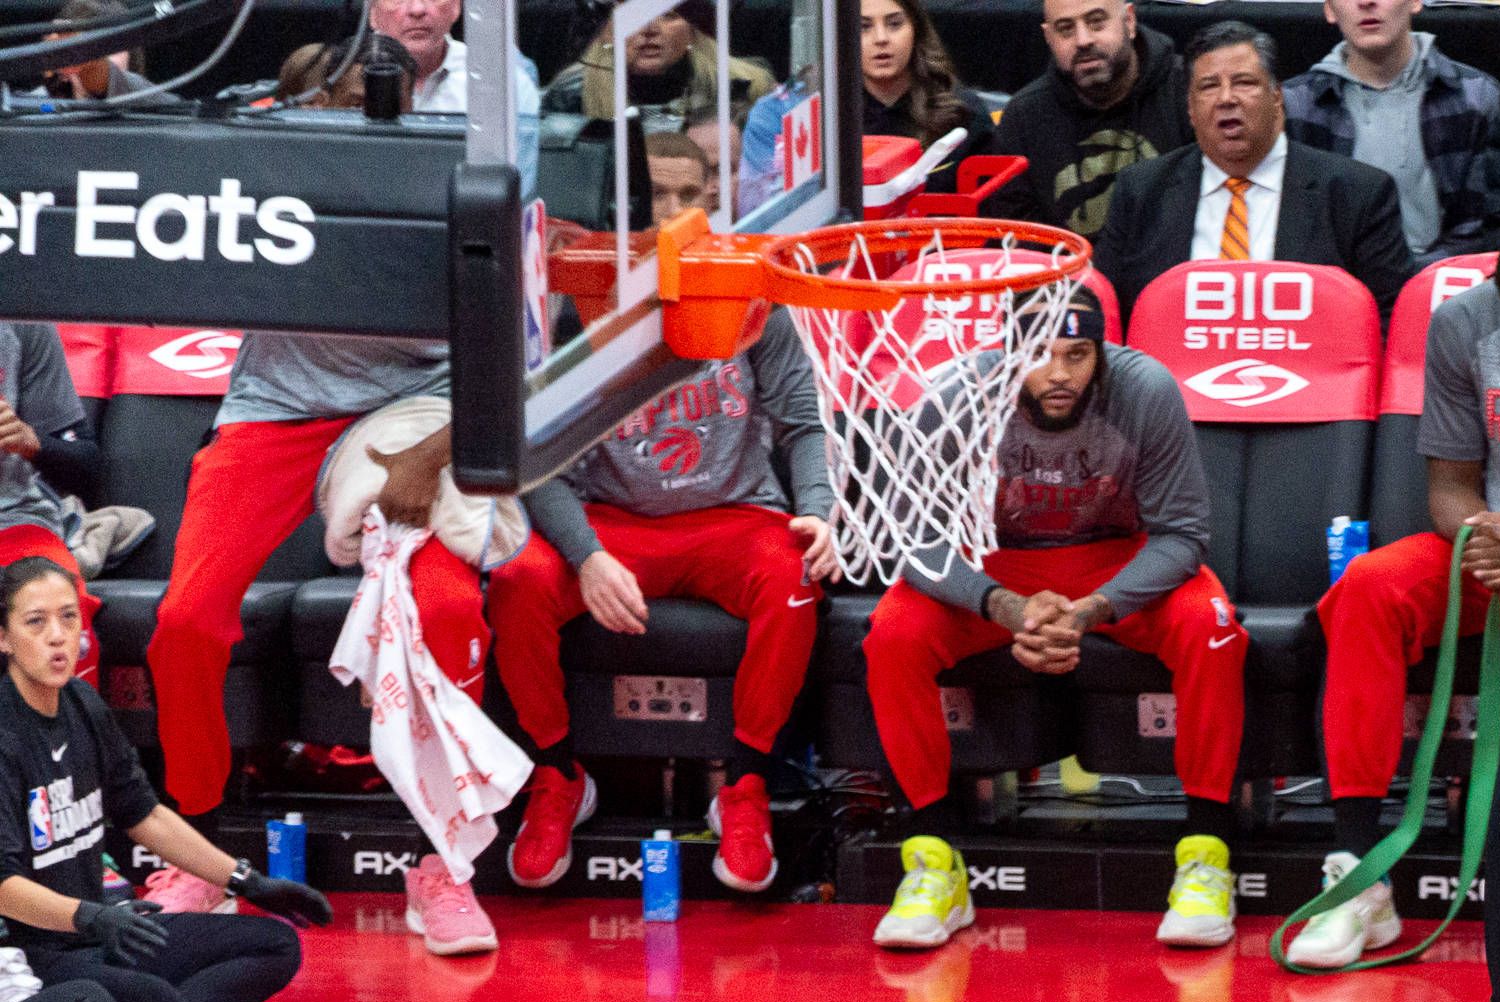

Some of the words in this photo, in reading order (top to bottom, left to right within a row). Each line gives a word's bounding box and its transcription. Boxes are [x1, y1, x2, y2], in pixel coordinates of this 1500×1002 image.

[75, 170, 317, 265] Eats
[1185, 271, 1313, 321] BIO
[1183, 326, 1313, 350] STEEL
[353, 851, 417, 875] AX
[587, 856, 644, 881] AX
[967, 866, 1026, 892] XE
